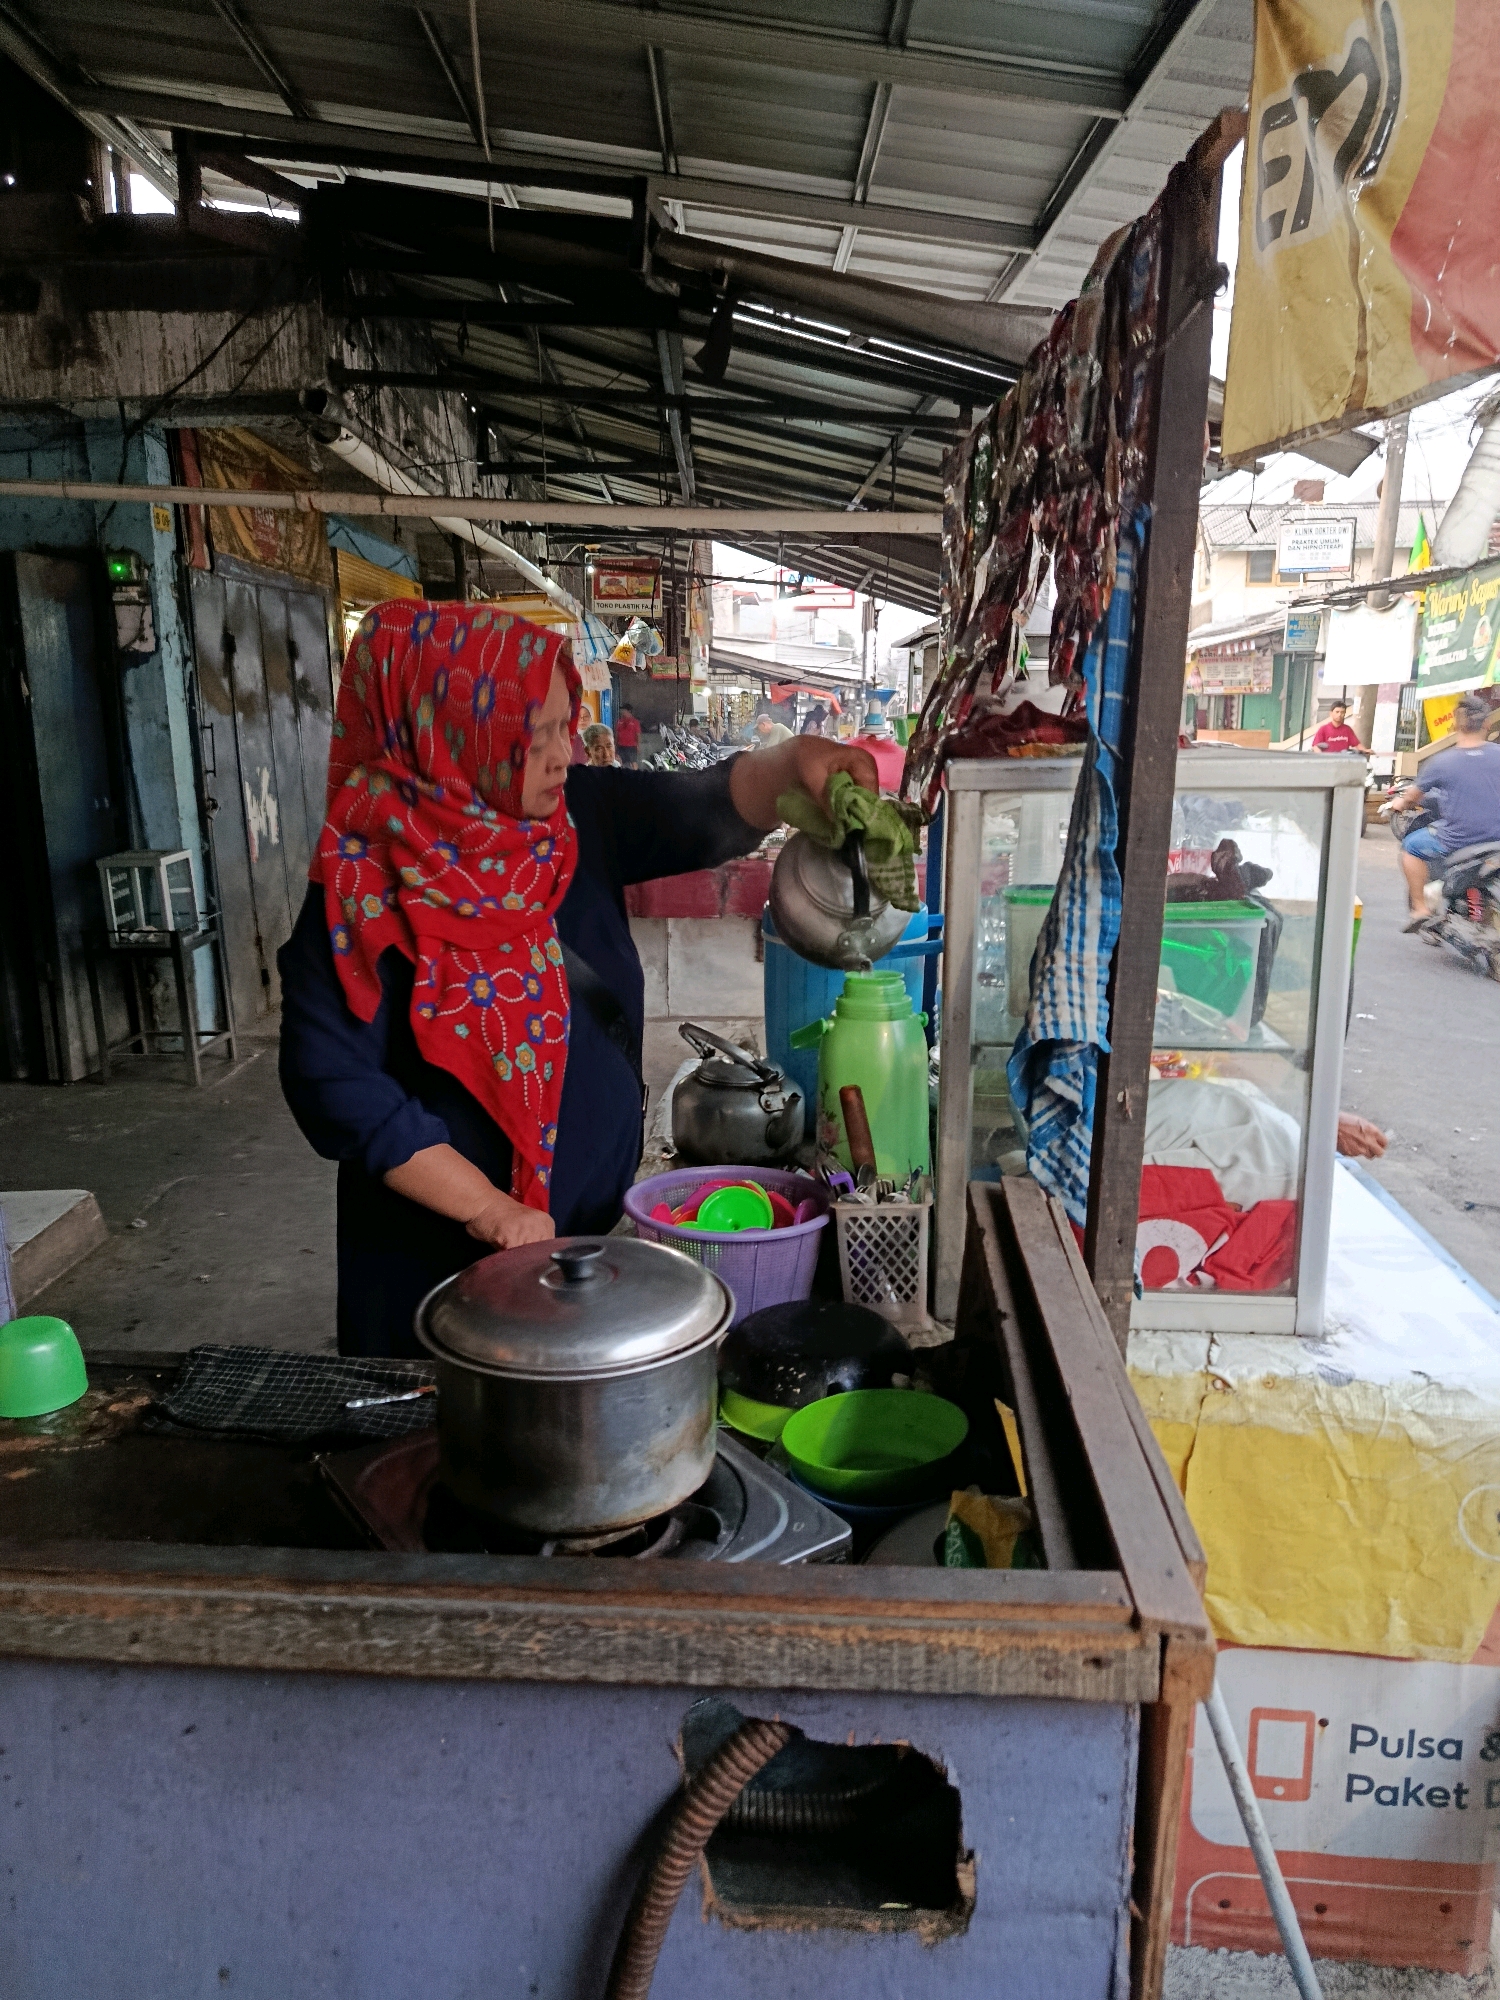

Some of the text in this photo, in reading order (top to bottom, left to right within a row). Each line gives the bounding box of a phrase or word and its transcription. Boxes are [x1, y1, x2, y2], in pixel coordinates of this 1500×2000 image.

[1295, 527, 1313, 536] KLINIK
[1315, 526, 1337, 535] DOKTER
[1303, 543, 1344, 551] HIPNOTERAPI
[1429, 589, 1469, 623] Warung
[1349, 1723, 1464, 1761] Pulsa
[1345, 1772, 1470, 1810] Paket
